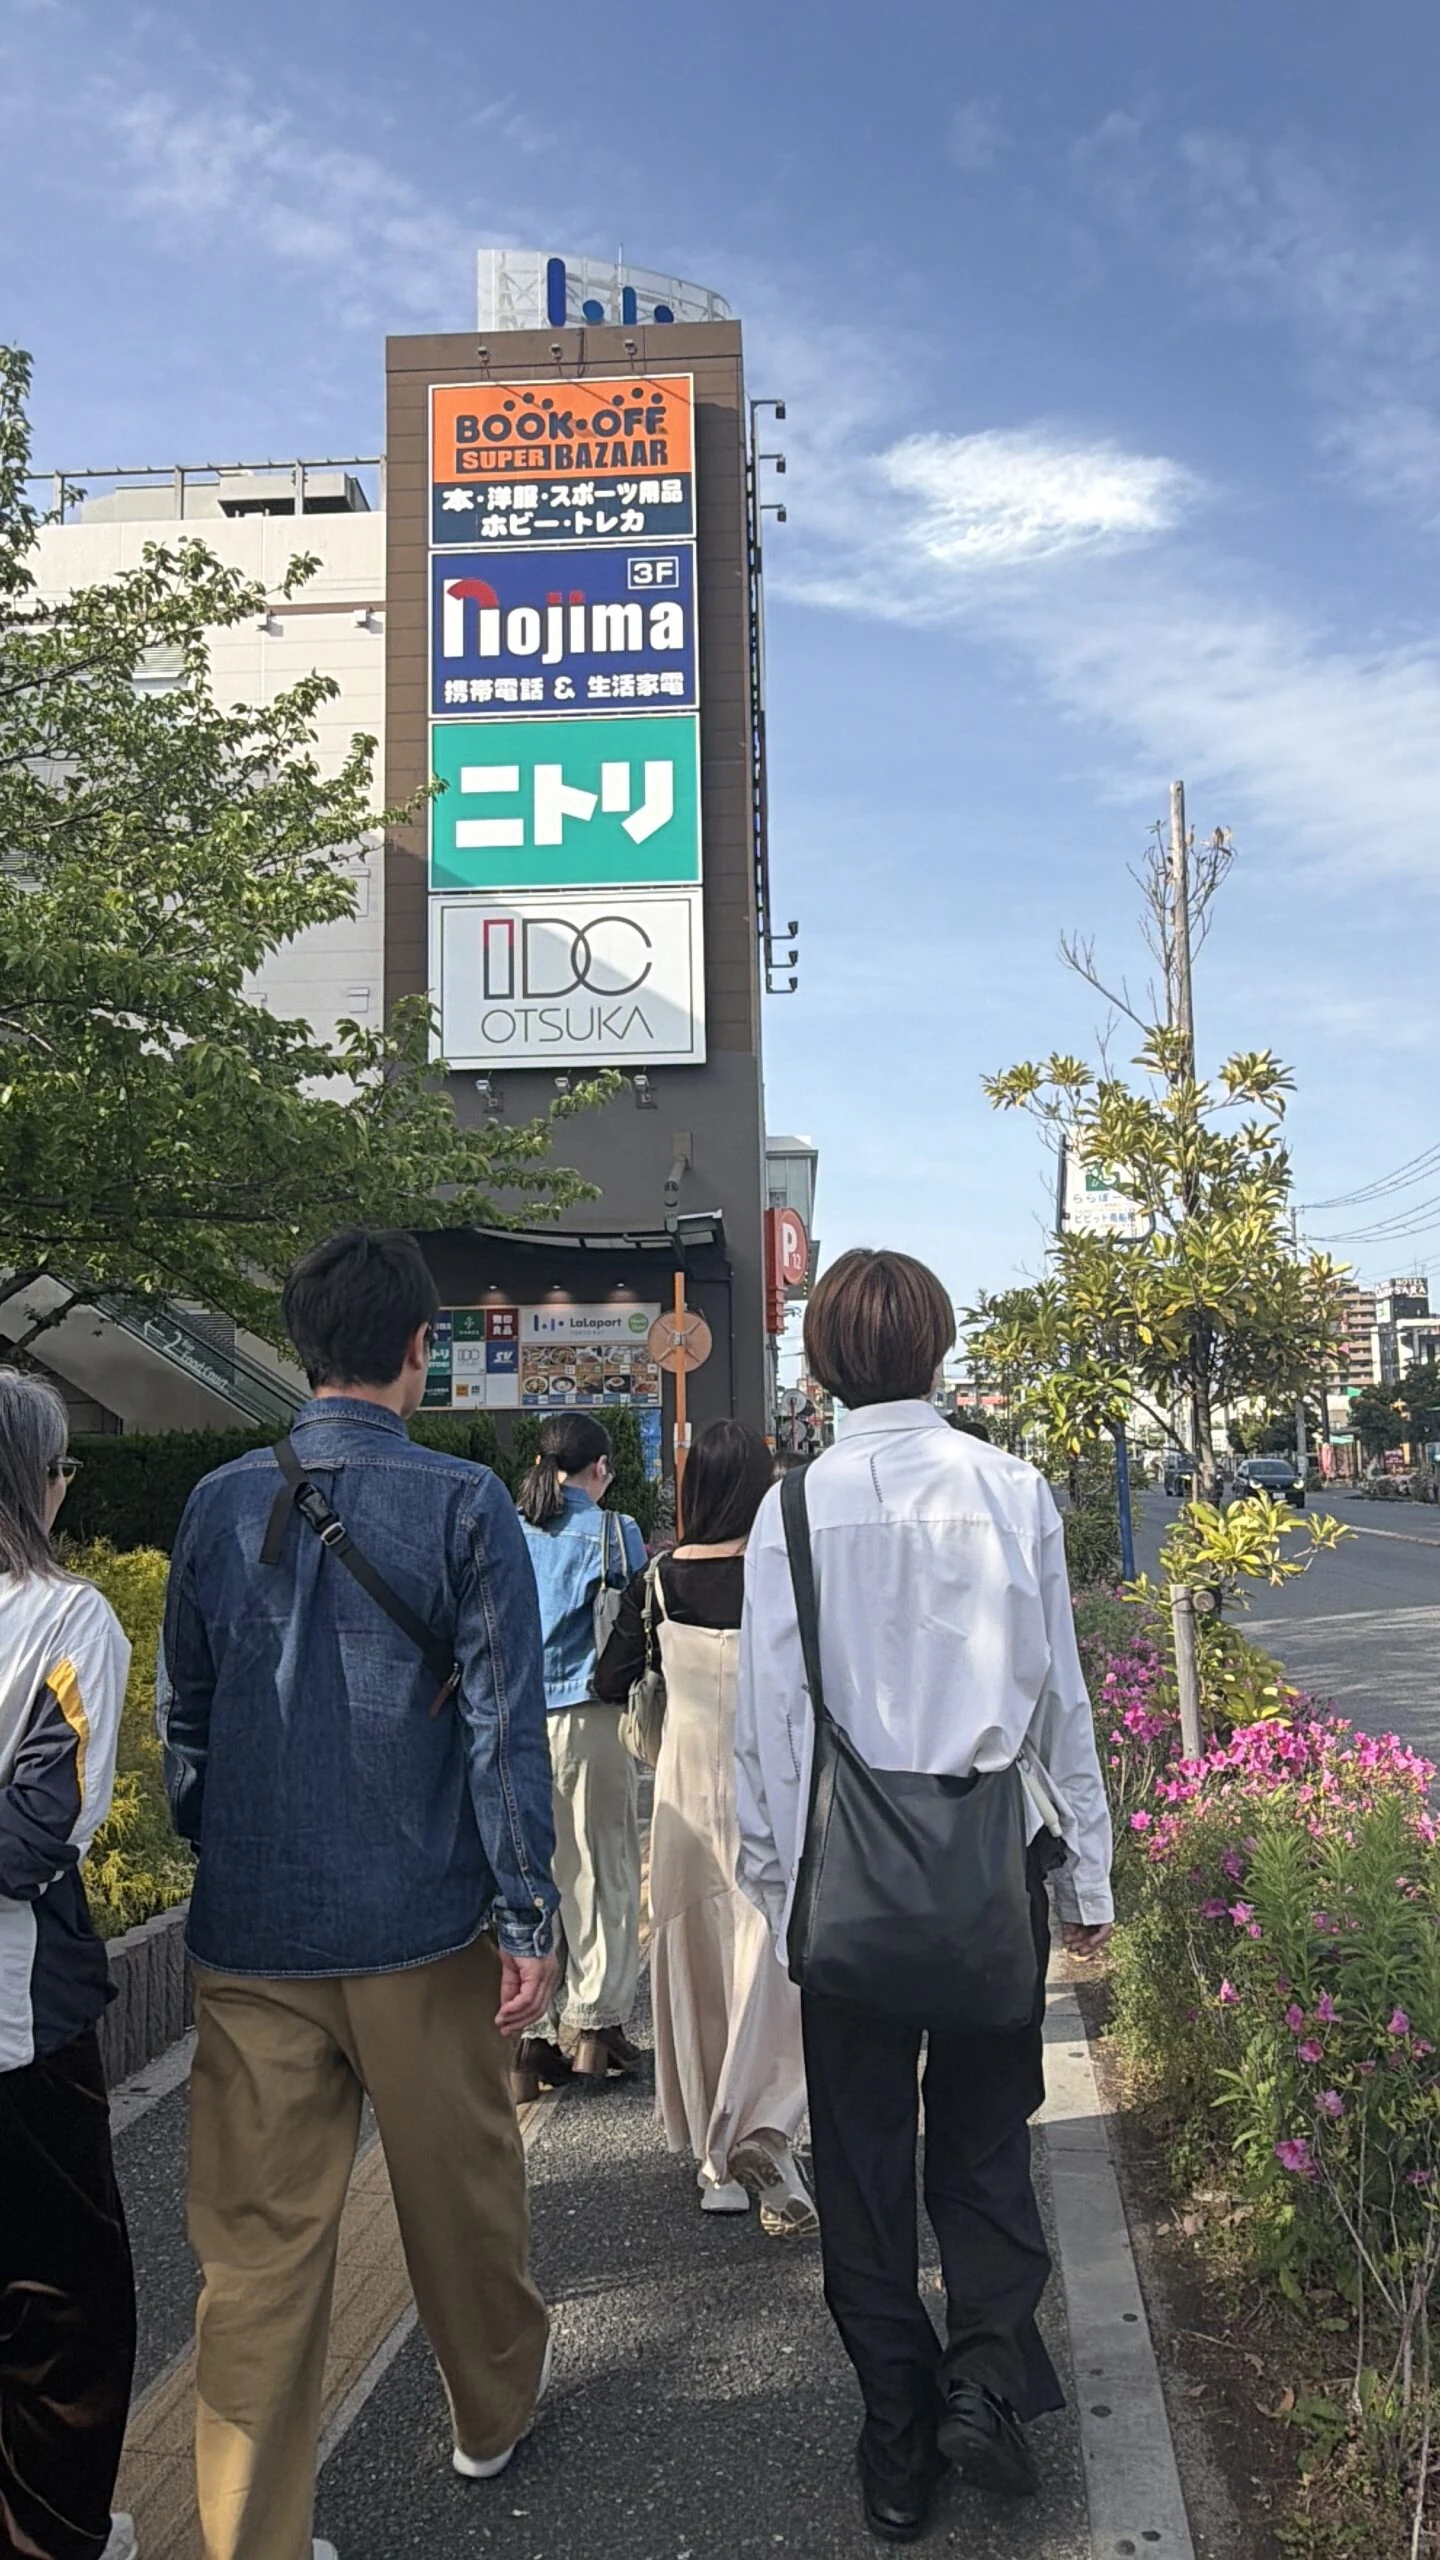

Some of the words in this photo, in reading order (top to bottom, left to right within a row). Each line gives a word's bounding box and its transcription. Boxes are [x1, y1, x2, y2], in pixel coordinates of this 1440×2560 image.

[462, 449, 545, 470] SUPER
[555, 440, 668, 471] BAZAAR
[481, 508, 644, 537] ホビー・トレカ
[633, 561, 674, 584] 3F
[443, 578, 684, 664] nojima
[444, 677, 544, 704] 携帯電話
[554, 676, 575, 699] &
[587, 671, 684, 698] 生活家電
[456, 760, 673, 848] ニトリ
[483, 916, 653, 1000] IDC
[481, 1005, 654, 1043] OTSUKA
[1073, 1193, 1133, 1204] ららぽー
[782, 1222, 798, 1267] P
[791, 1253, 802, 1270] 12
[1394, 1285, 1426, 1295] SARA
[570, 1317, 622, 1330] LaLaport
[162, 1330, 183, 1359] 2
[431, 1348, 450, 1360] トリ
